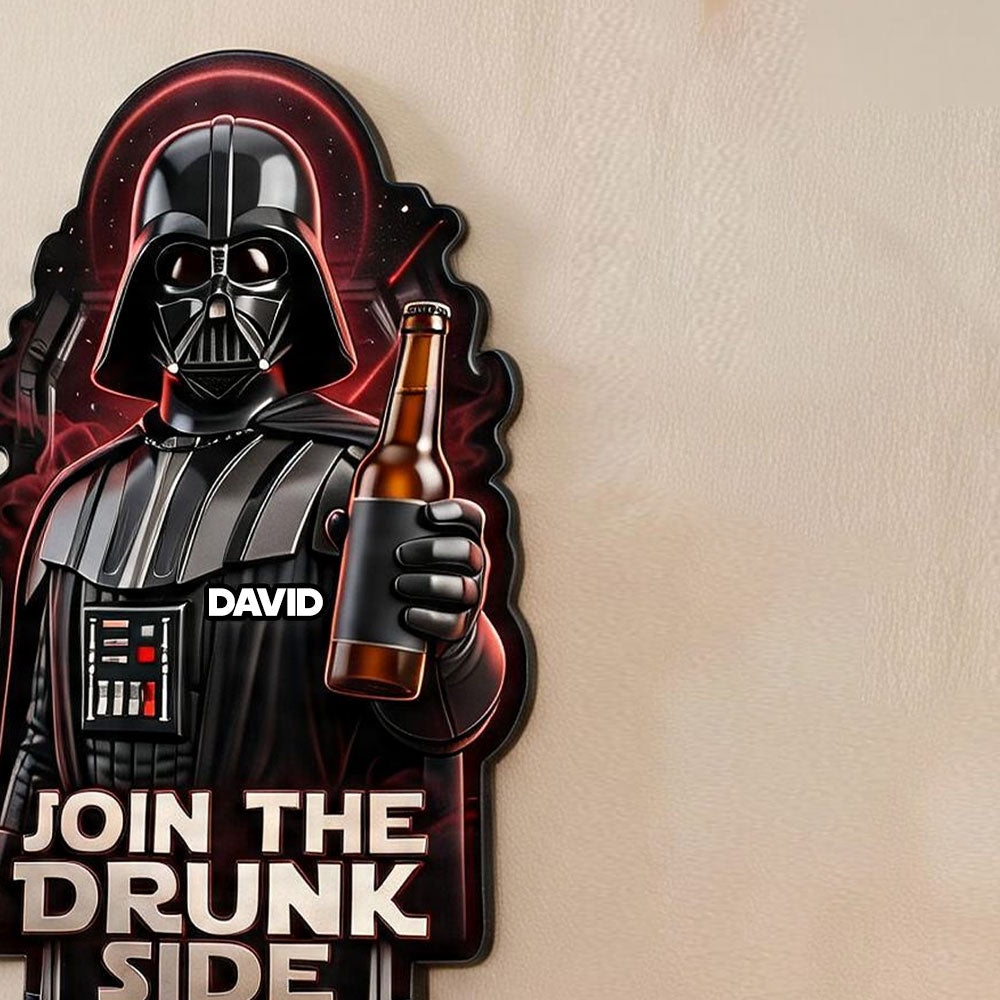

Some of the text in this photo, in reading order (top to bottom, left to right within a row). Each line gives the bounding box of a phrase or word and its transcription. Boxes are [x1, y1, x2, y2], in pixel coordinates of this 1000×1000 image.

[208, 588, 323, 617] DAVID
[23, 790, 428, 855] JOIN THE
[13, 861, 429, 937] DRUNK
